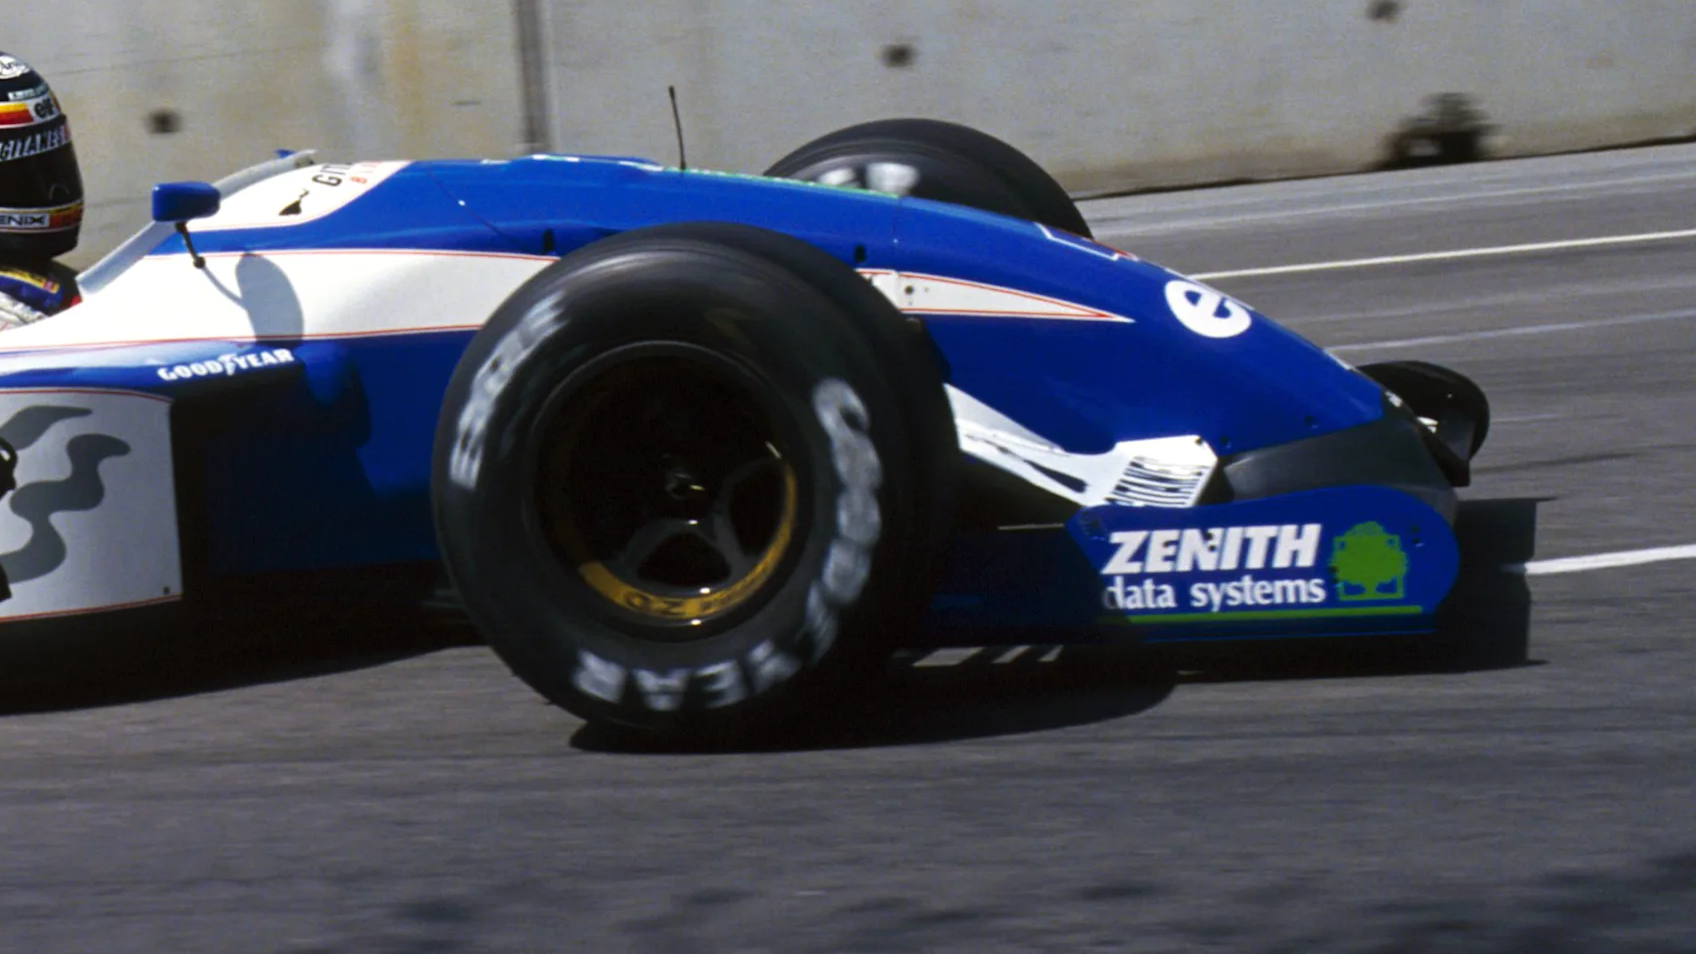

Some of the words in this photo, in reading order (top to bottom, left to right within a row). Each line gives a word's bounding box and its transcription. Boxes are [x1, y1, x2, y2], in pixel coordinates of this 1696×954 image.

[157, 348, 295, 381] GOODYEAR
[1100, 523, 1322, 575] ZENITH
[1103, 575, 1178, 610] data
[1189, 574, 1327, 613] systems
